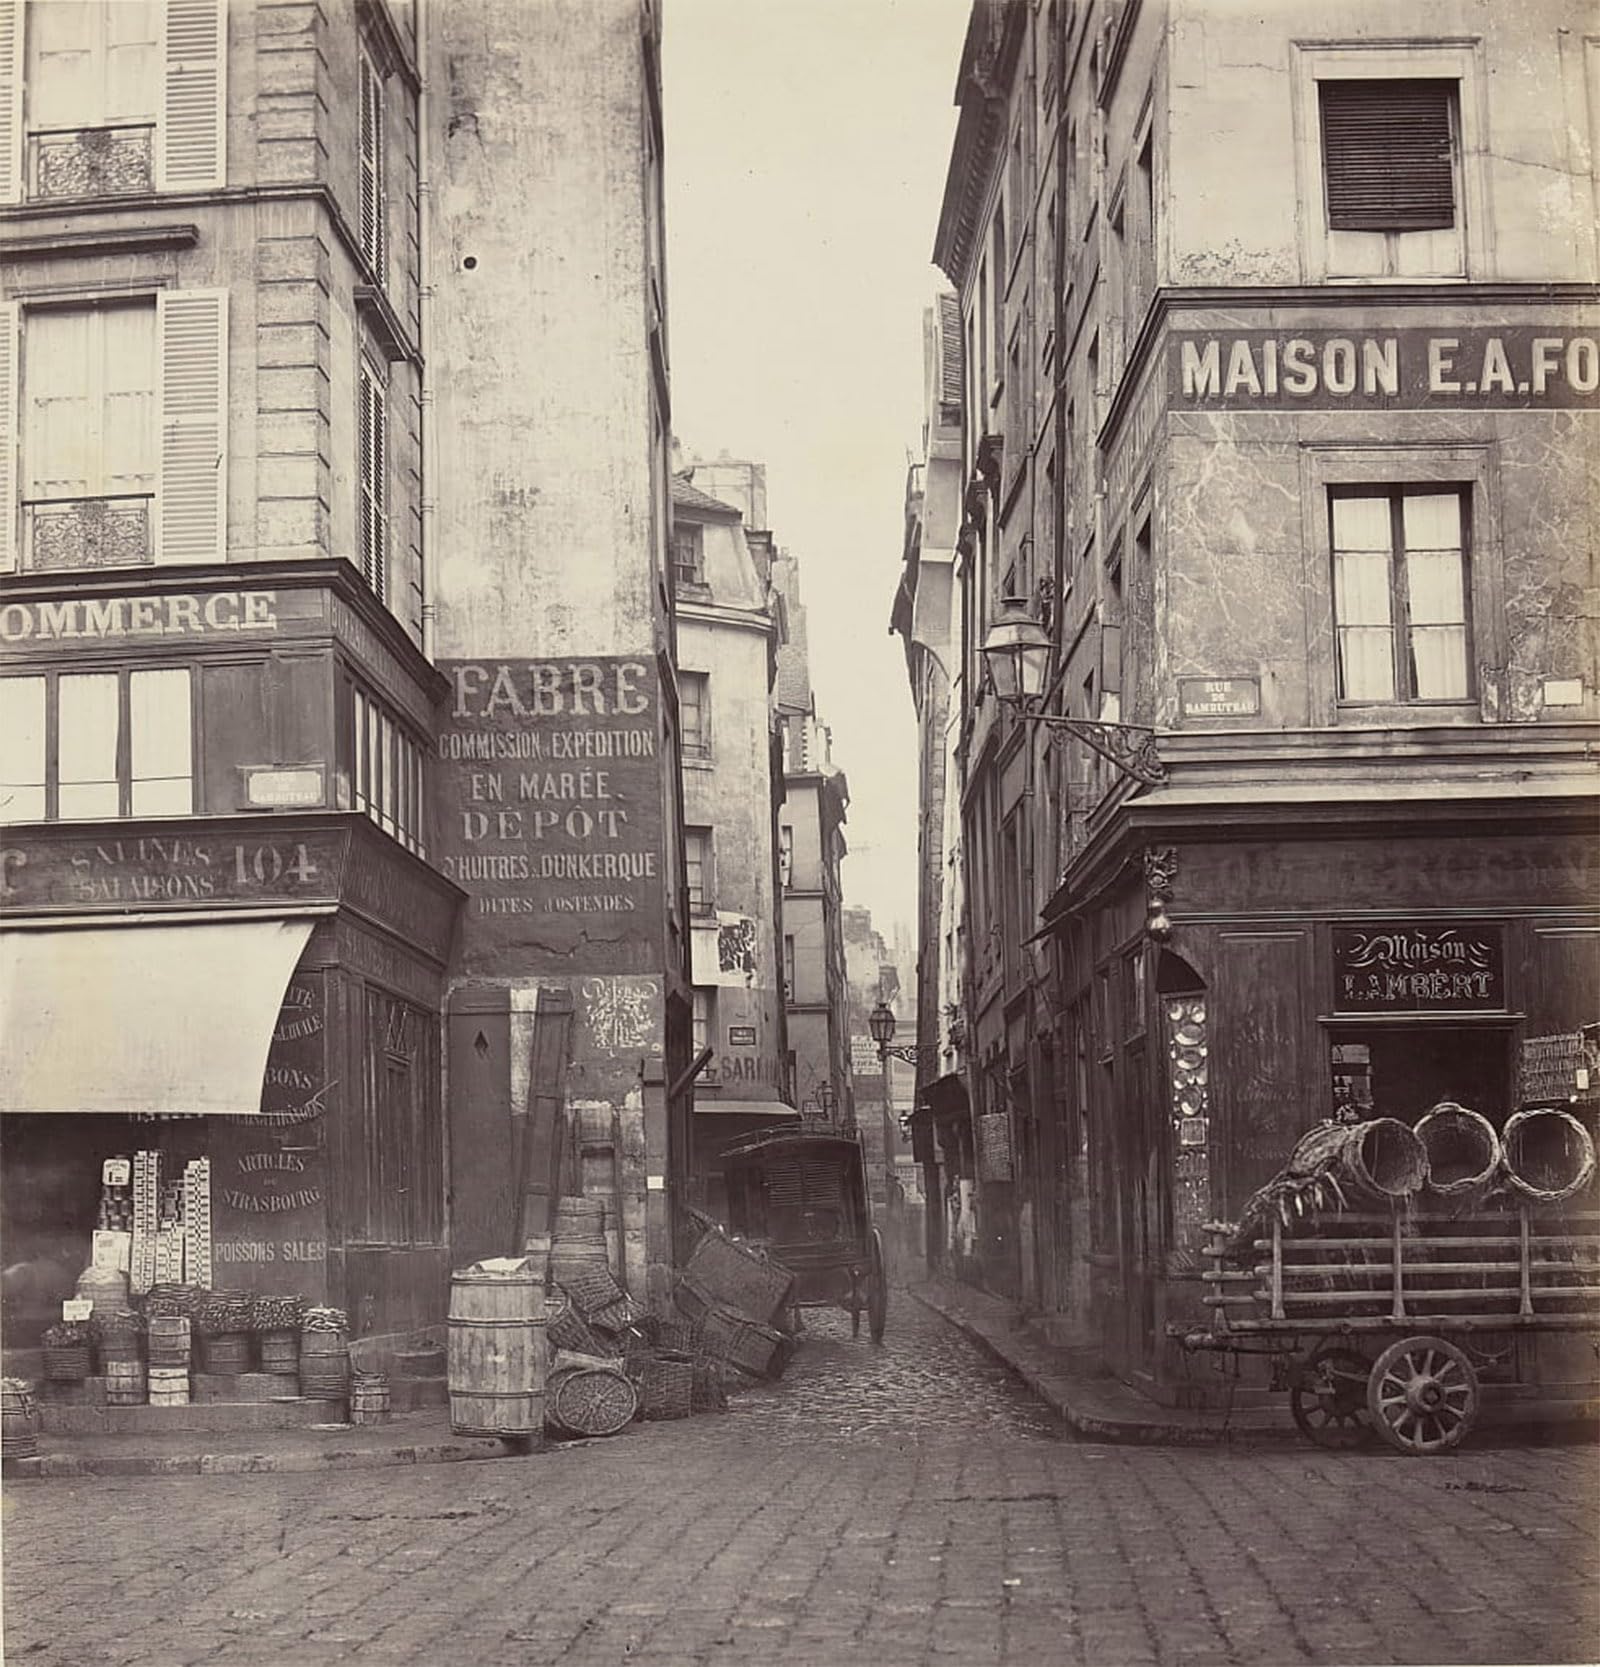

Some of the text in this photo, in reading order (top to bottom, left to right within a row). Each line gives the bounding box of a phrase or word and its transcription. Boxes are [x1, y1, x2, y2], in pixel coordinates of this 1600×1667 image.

[1180, 338, 1399, 396] MAISON
[0, 591, 278, 641] OMMERCE
[452, 662, 650, 718] FABRE
[1205, 682, 1231, 693] RUE
[439, 731, 543, 760] COMMISSION
[472, 773, 503, 801] EN
[459, 804, 628, 840] DÉPÔT
[234, 843, 319, 888] 104
[214, 1241, 326, 1262] POISSONS SALES
